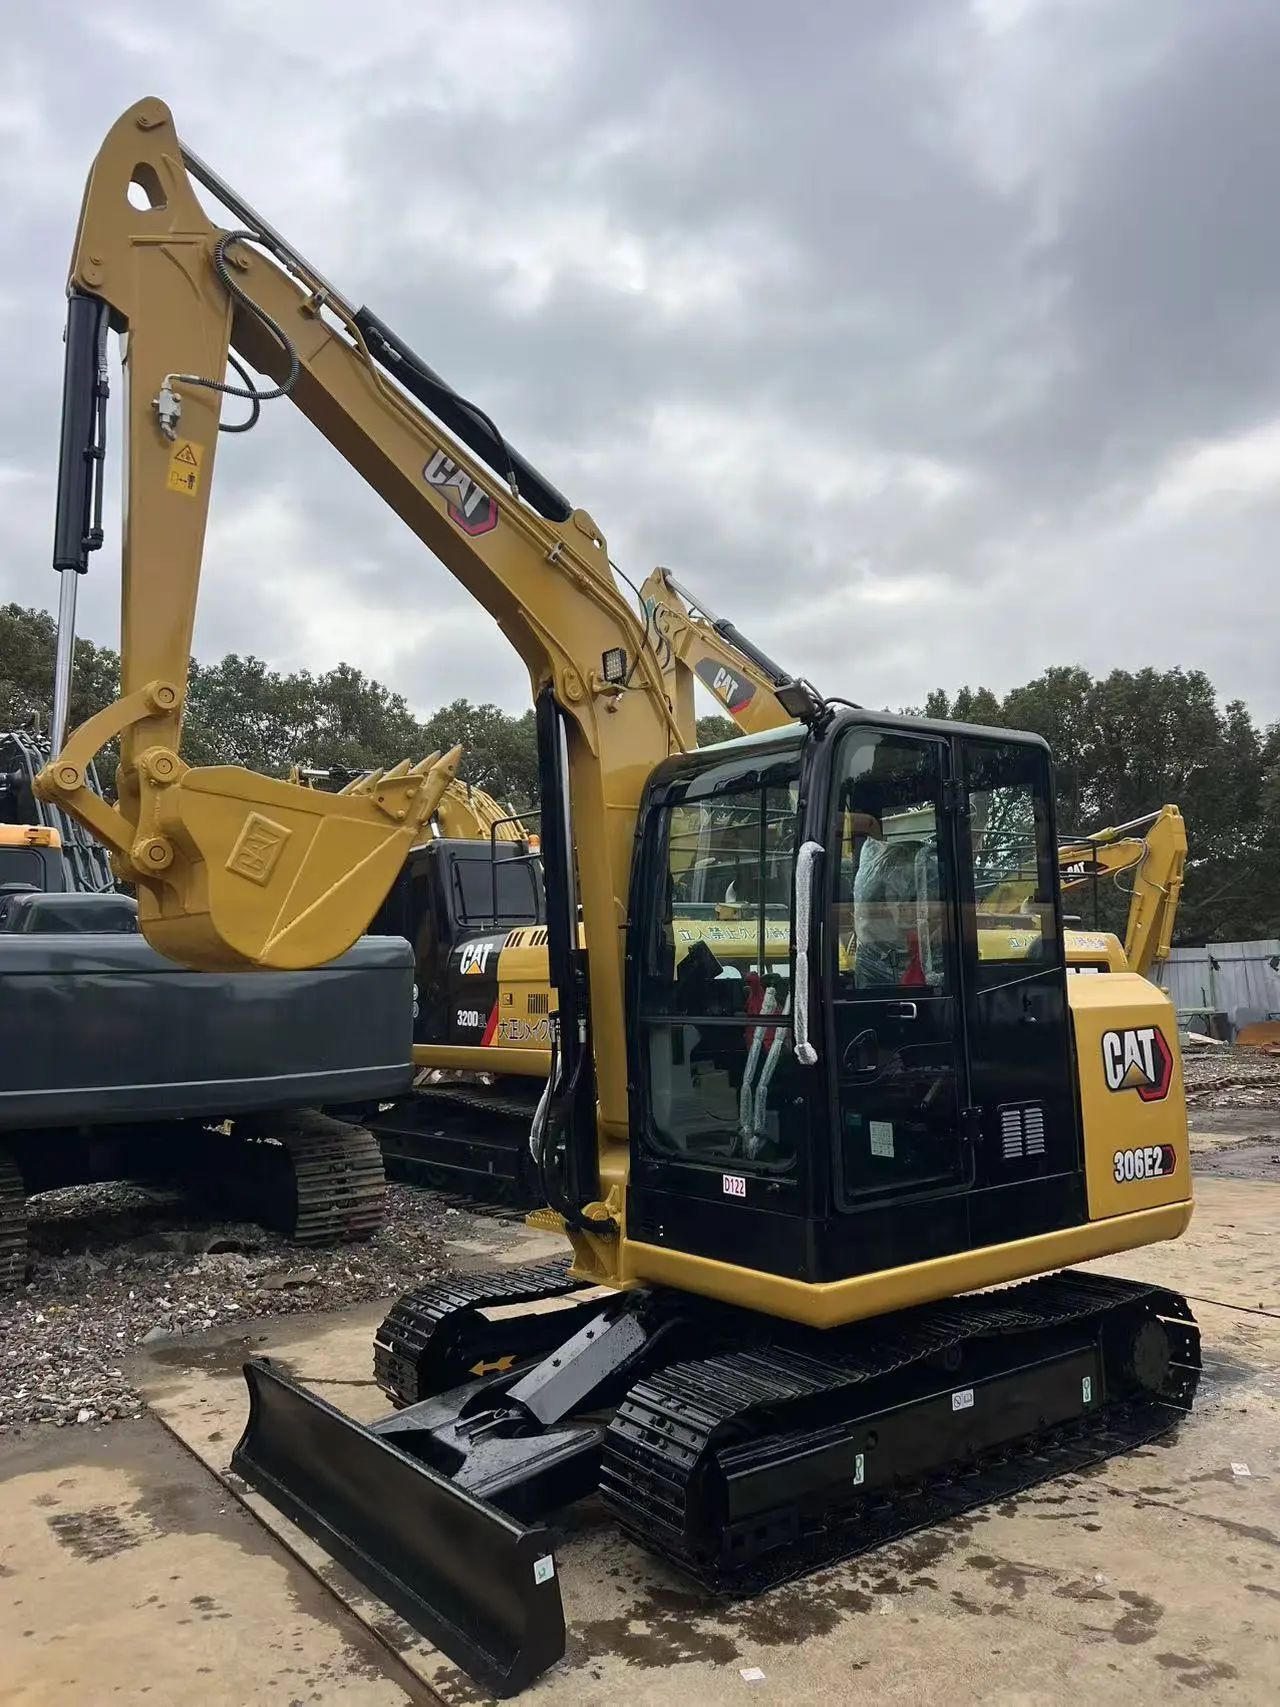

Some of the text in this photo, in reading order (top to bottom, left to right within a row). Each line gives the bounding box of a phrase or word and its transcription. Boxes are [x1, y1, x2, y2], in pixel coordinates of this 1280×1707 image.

[424, 449, 486, 518] CAT
[713, 667, 739, 703] CAT
[237, 820, 281, 872] CAT
[460, 944, 495, 975] CAT
[457, 1009, 479, 1027] 320D
[1103, 1028, 1156, 1089] CAT
[1114, 1146, 1163, 1183] 306E2
[724, 1176, 745, 1195] D122
